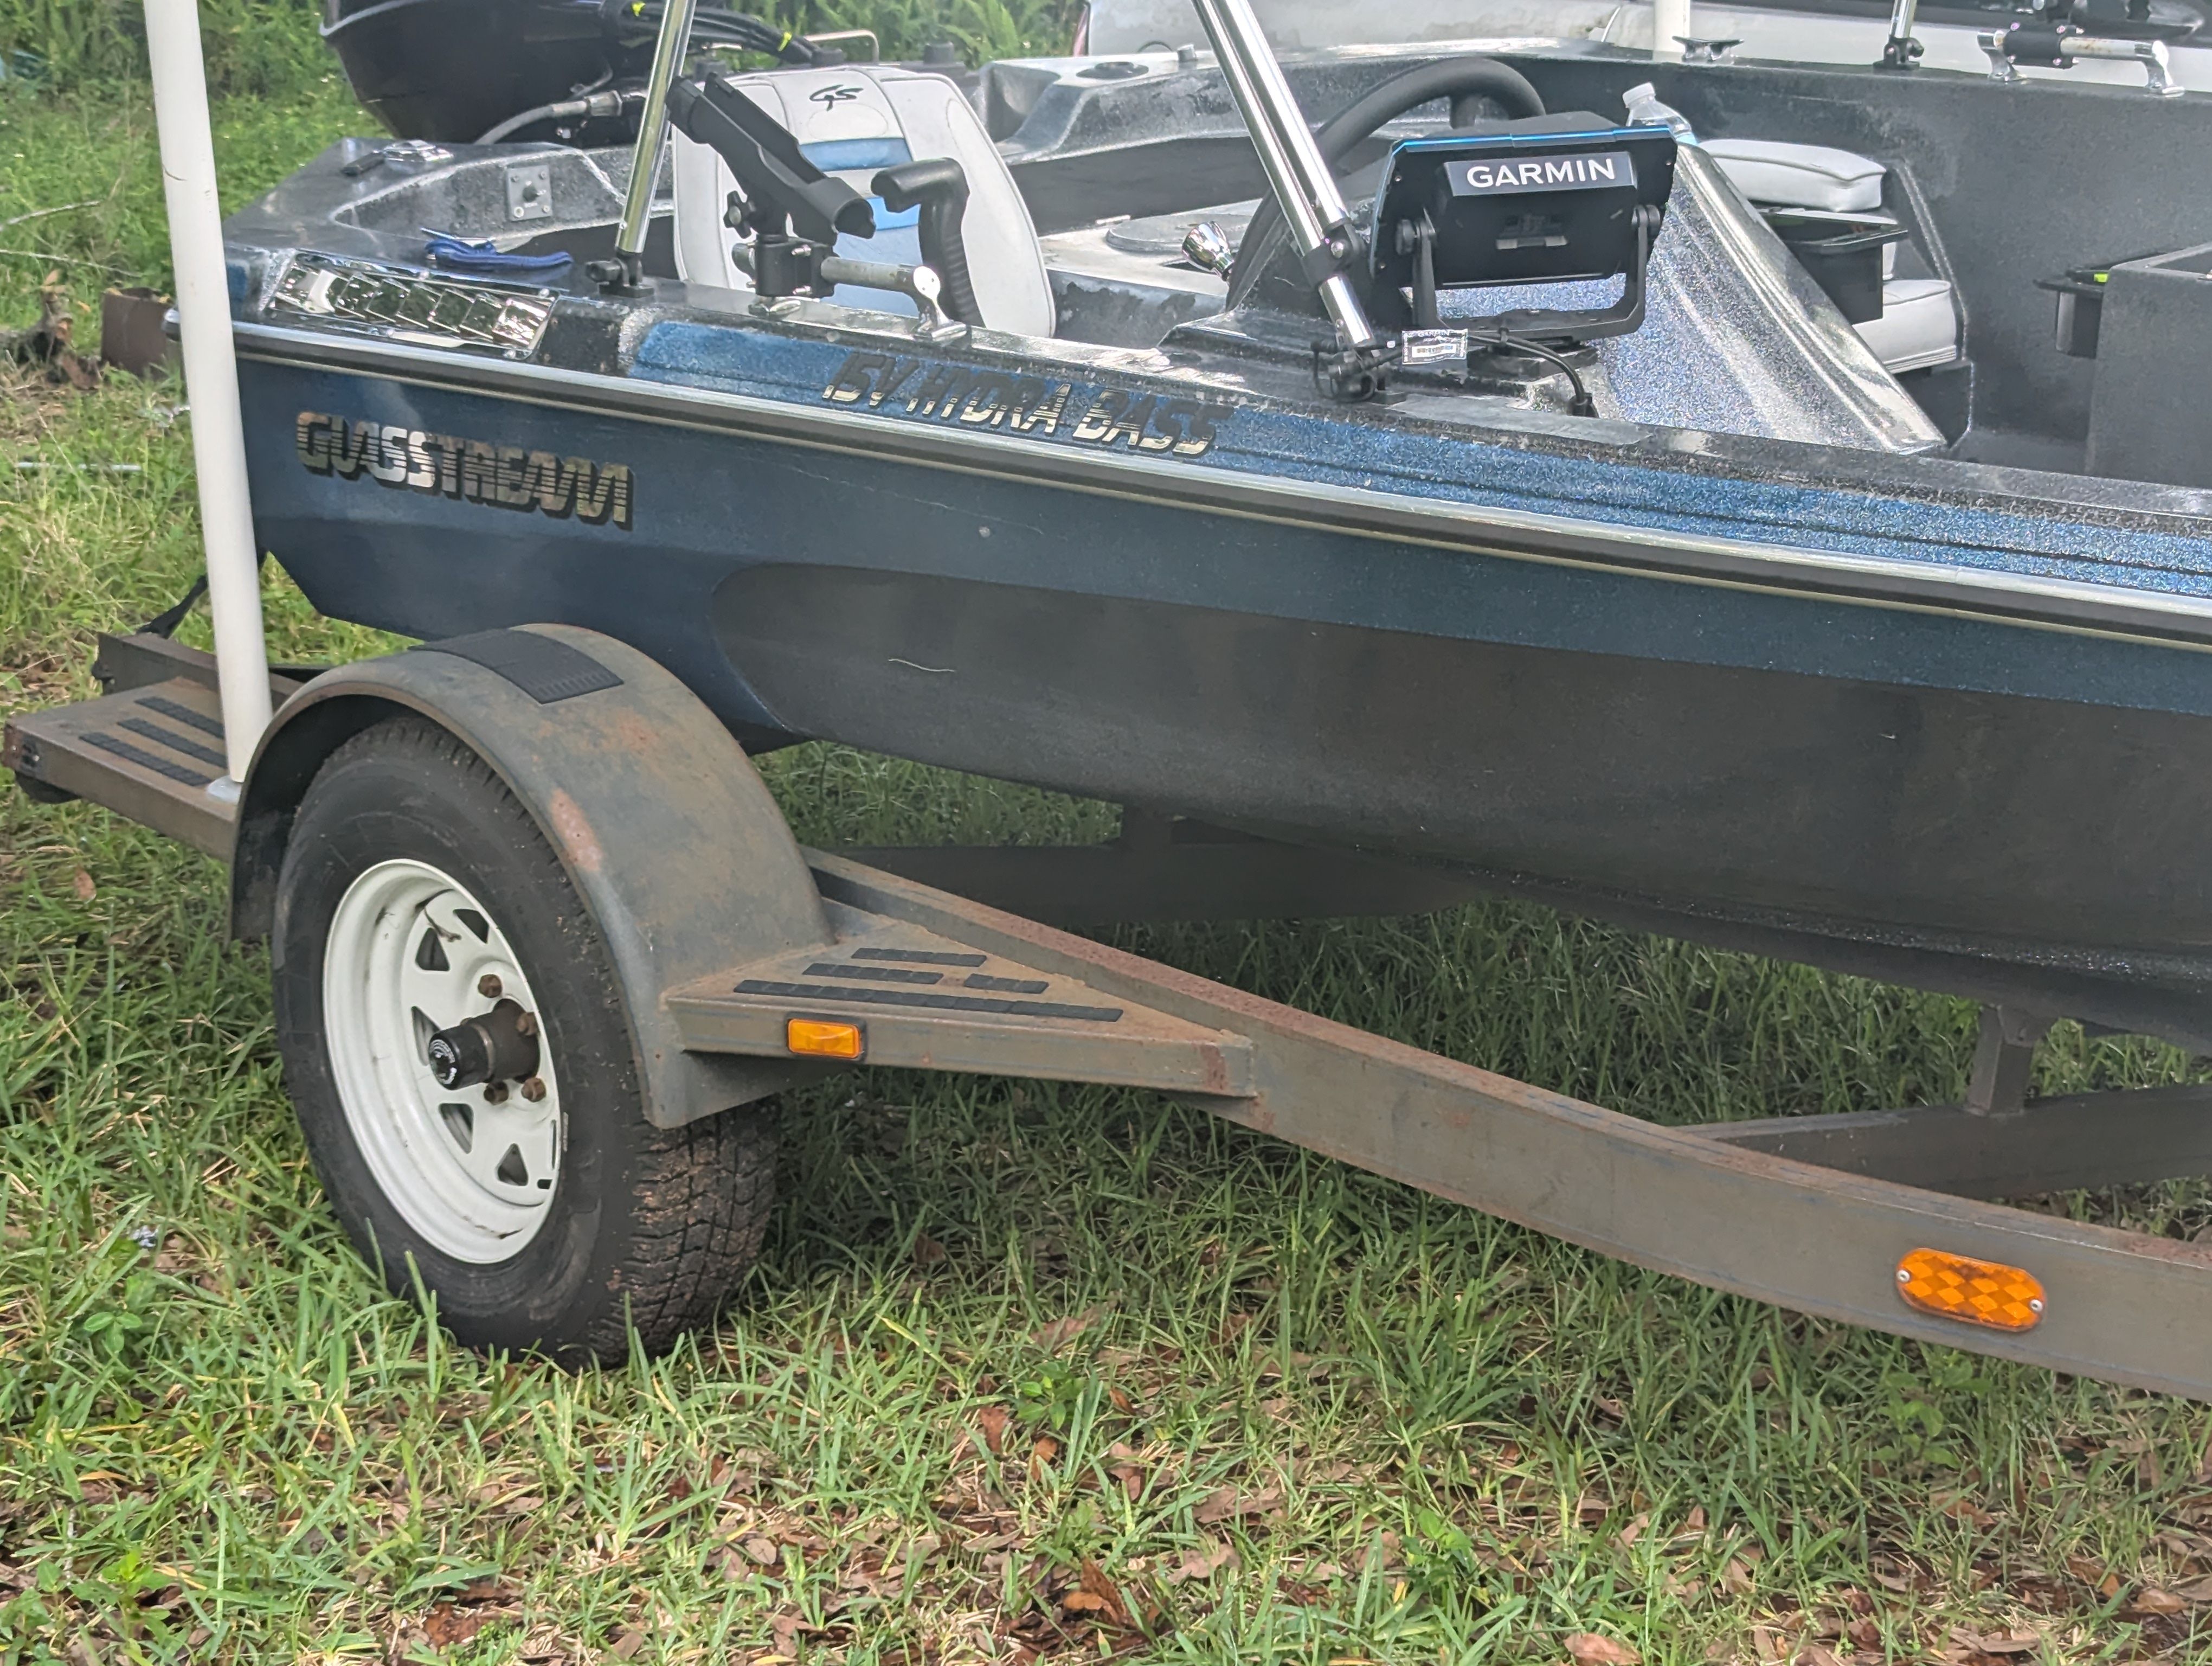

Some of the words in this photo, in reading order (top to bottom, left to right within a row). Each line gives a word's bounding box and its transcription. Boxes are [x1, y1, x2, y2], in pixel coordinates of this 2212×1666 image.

[1467, 158, 1615, 188] GARMIN
[905, 363, 1072, 435] HYDRA
[1071, 388, 1234, 458] BASS
[296, 412, 634, 531] GLASSTREAM
